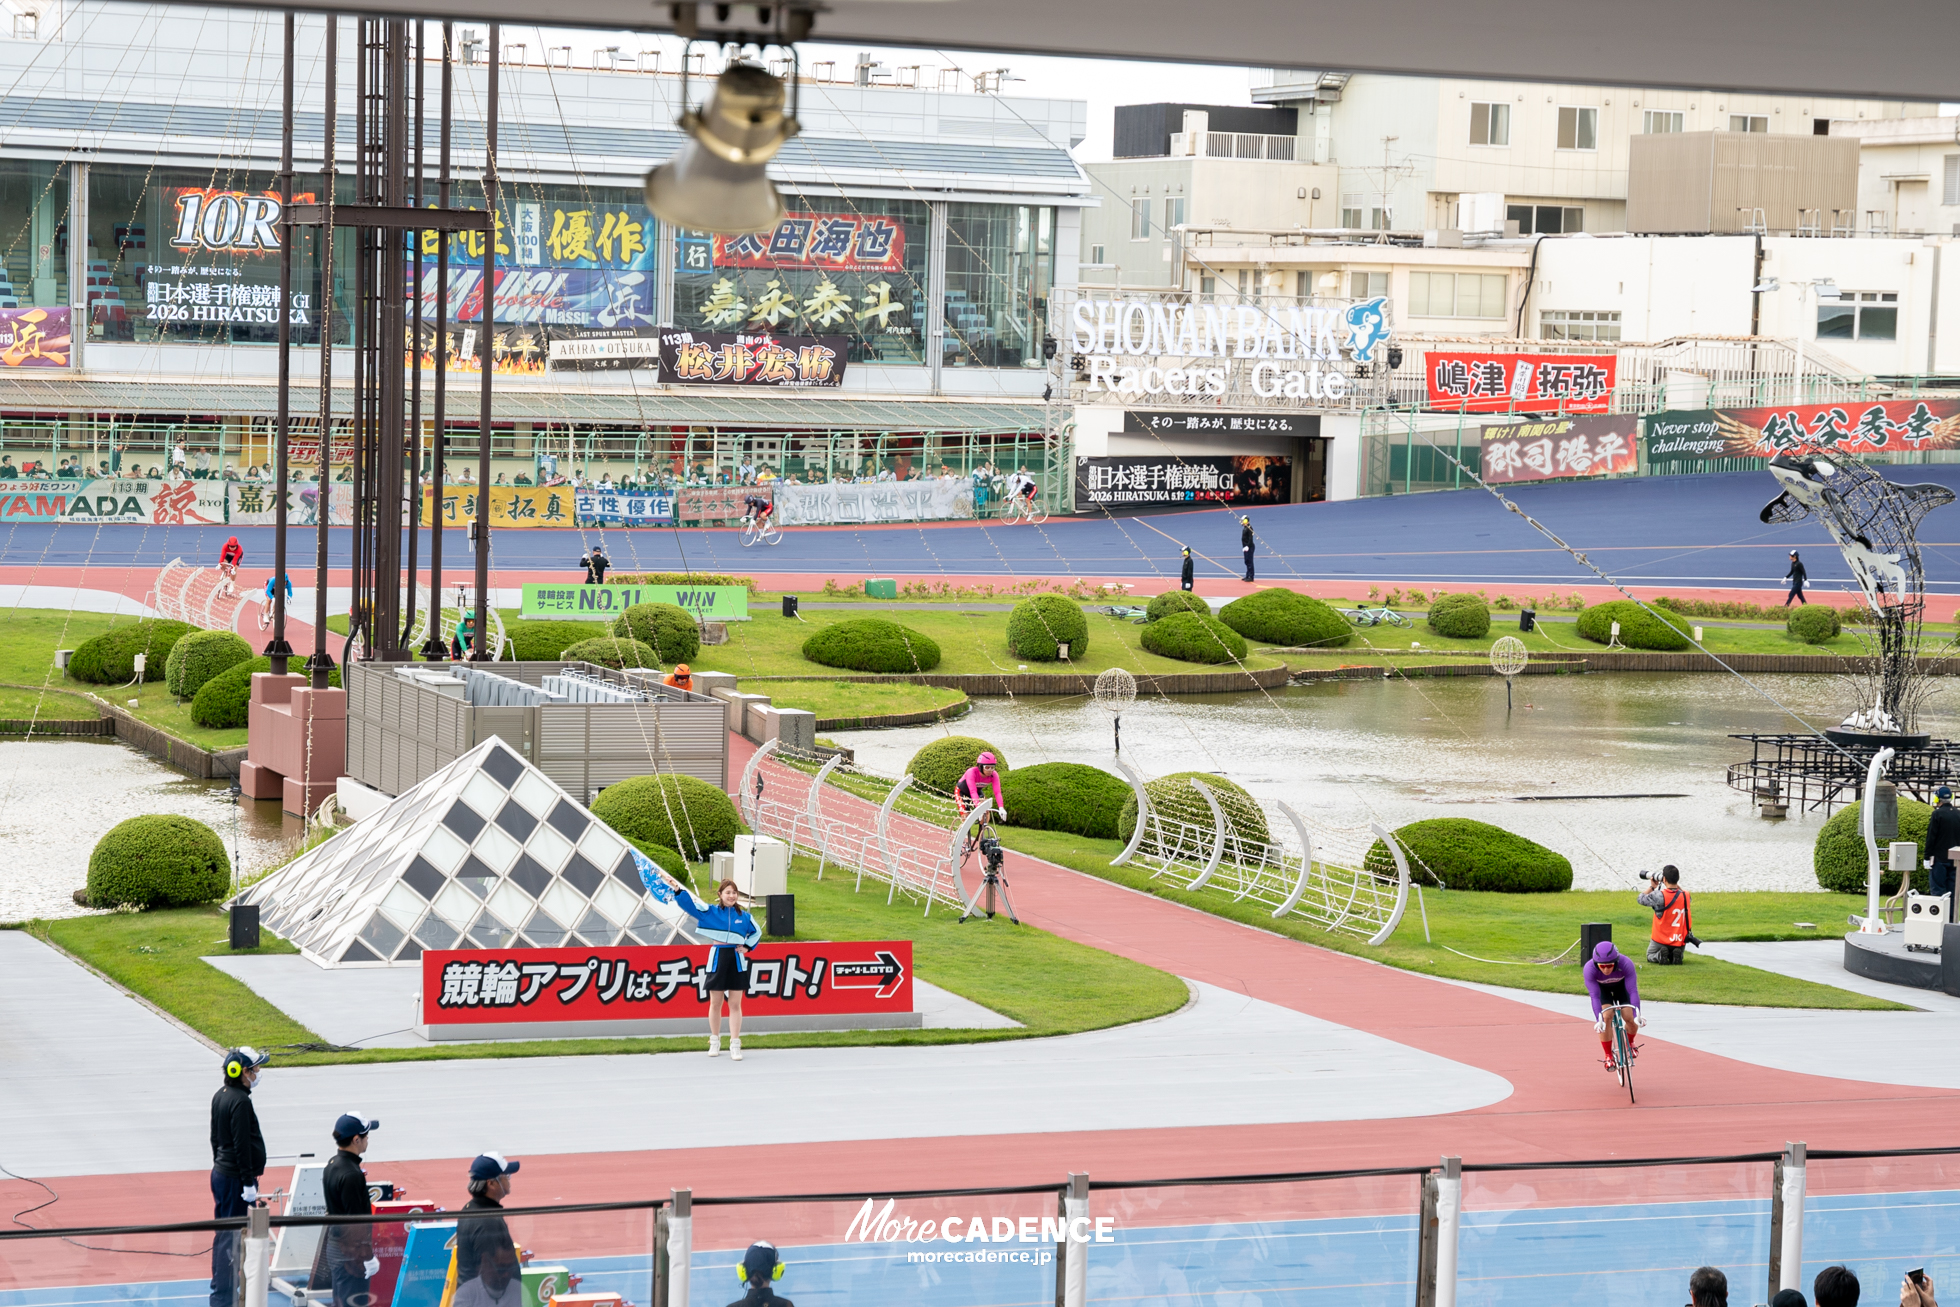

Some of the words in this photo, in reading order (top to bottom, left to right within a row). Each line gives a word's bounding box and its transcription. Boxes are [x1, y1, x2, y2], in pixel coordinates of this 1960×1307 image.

[172, 193, 281, 246] 10R
[548, 209, 645, 263] 優作
[147, 304, 188, 320] 2026
[699, 277, 904, 328] 嘉永泰斗
[662, 332, 693, 345] 113期
[1072, 300, 1231, 357] SHONAN
[1236, 305, 1342, 361] BANK
[560, 344, 596, 355] AKIRA
[607, 342, 652, 353] OTSUKA
[674, 342, 836, 381] 松井宏佑
[1251, 361, 1346, 400] Gate
[1437, 360, 1505, 396] 嶋津
[1538, 364, 1607, 399] 拓弥
[1150, 416, 1293, 431] その一踏みが、歴史になる。
[1652, 421, 1692, 437] Never
[1693, 424, 1720, 438] stop
[1757, 402, 1941, 452] 松谷秀幸
[1485, 432, 1628, 478] 郡司浩平
[1651, 438, 1725, 454] challenging
[1097, 464, 1219, 490] 日本選手権競輪
[507, 494, 566, 521] 拓真
[1088, 491, 1113, 501] 2026
[1114, 491, 1170, 500] HIRATSUKA
[538, 601, 573, 610] サービス
[1671, 908, 1686, 927] 21
[1669, 933, 1684, 942] JK
[537, 1275, 558, 1303] 6
